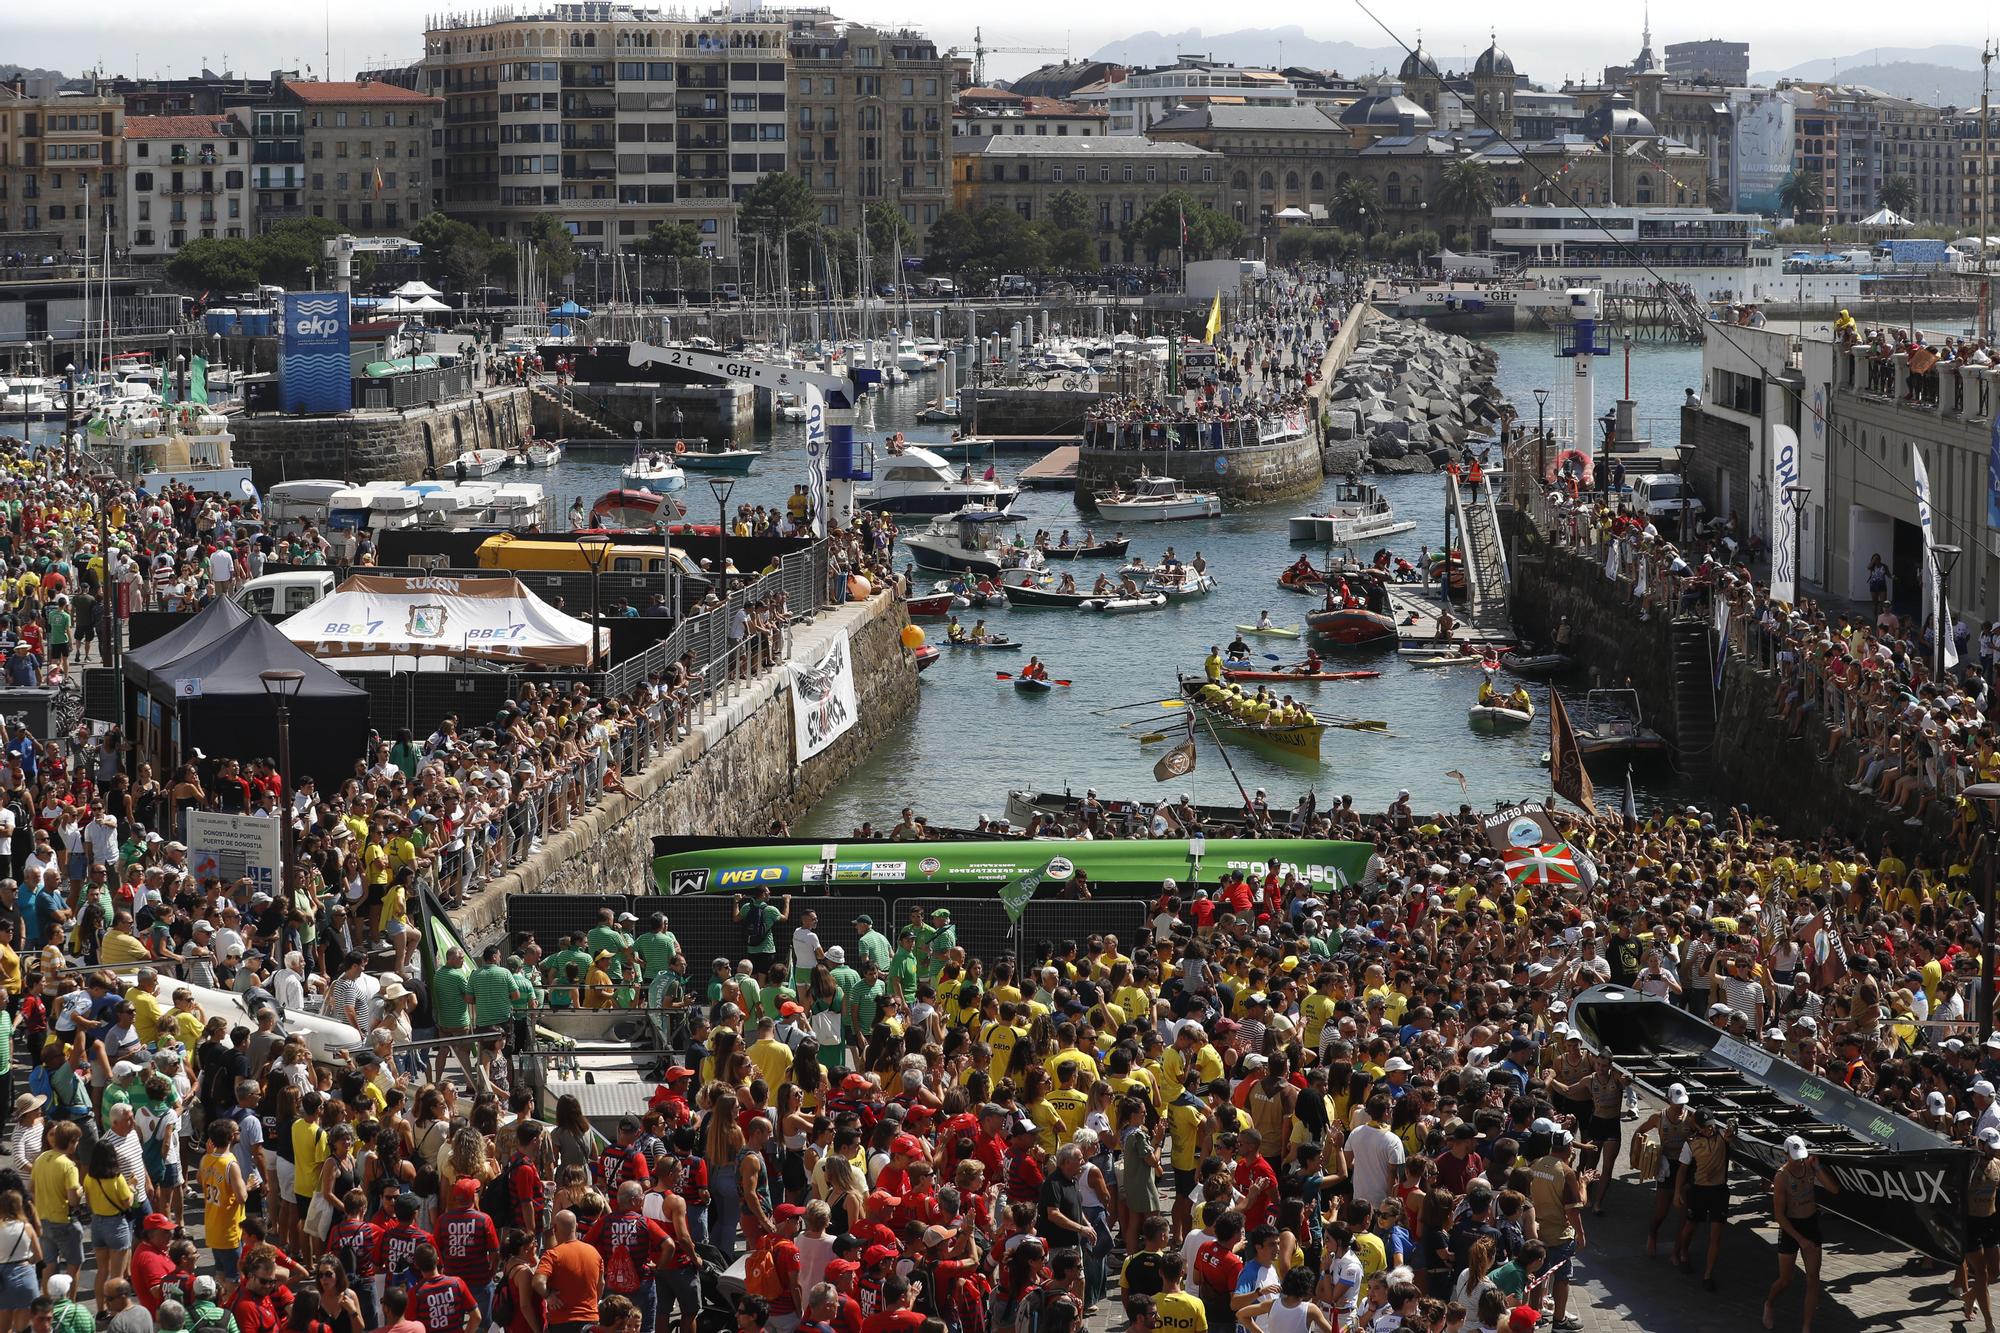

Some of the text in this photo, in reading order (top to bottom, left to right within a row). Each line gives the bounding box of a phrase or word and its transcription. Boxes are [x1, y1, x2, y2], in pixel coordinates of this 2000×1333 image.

[1741, 163, 1791, 173] NAUFRAGOAK
[1491, 292, 1510, 301] GH
[297, 315, 339, 338] ekp
[671, 352, 681, 364] 2
[726, 363, 752, 378] GH
[663, 504, 670, 516] 3
[203, 829, 262, 840] DONOSTIAKO PORTUA
[203, 838, 225, 846] PUERTO
[234, 840, 262, 849] DONOSTIA
[720, 870, 758, 884] BM
[448, 1219, 476, 1234] ond
[612, 1221, 637, 1234] ond
[389, 1238, 416, 1254] ond
[449, 1234, 469, 1246] arr
[611, 1234, 631, 1246] arr
[450, 1246, 466, 1257] oa
[427, 1287, 454, 1307] ond
[429, 1304, 451, 1318] arr
[430, 1315, 448, 1329] oa
